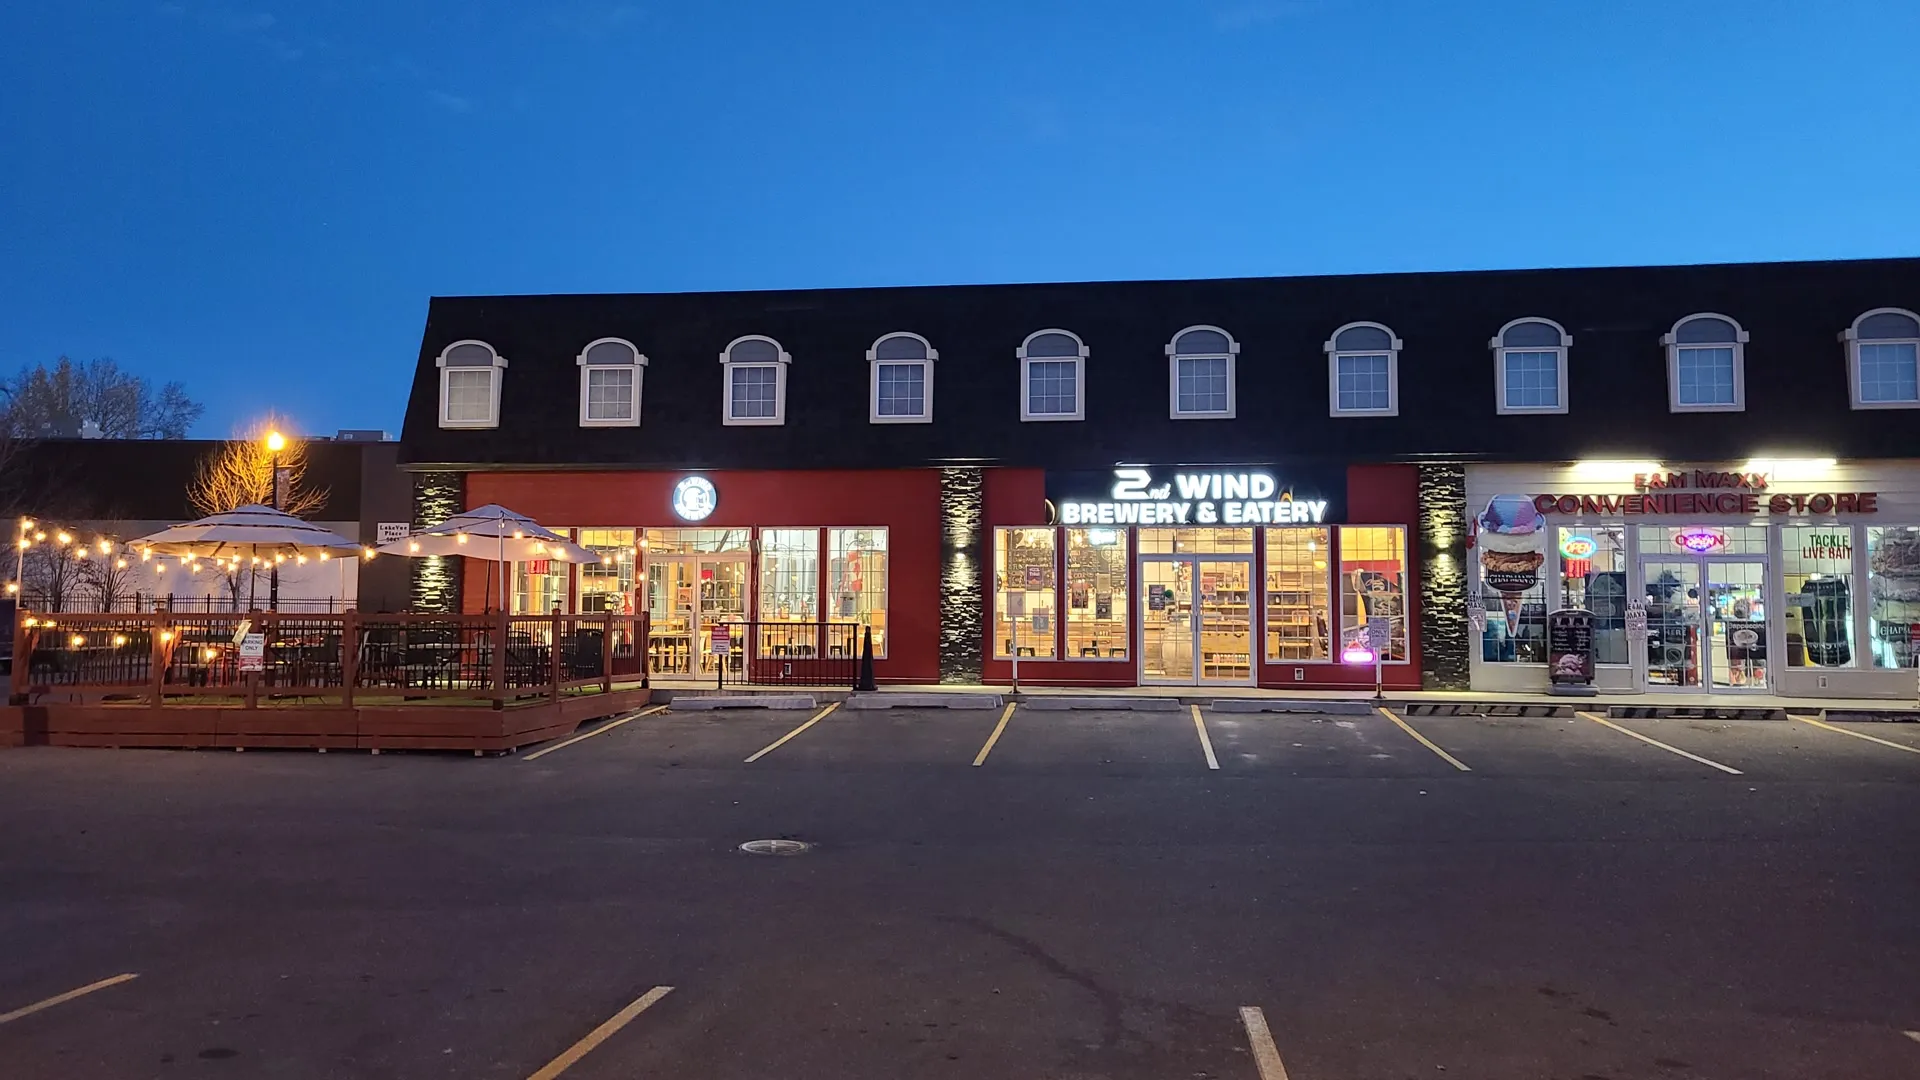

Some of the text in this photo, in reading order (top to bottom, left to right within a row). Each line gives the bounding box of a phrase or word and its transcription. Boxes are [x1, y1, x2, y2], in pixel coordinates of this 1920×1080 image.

[1112, 468, 1275, 500] 2nd WIND
[1635, 470, 1769, 489] E&M MAXX
[1062, 501, 1327, 524] BREWERY & EATERY
[1535, 492, 1878, 514] CONVENIENCE STORE
[1565, 541, 1593, 555] OPEN
[1809, 534, 1849, 548] TACKLE
[1803, 546, 1853, 560] LIVE BAIT
